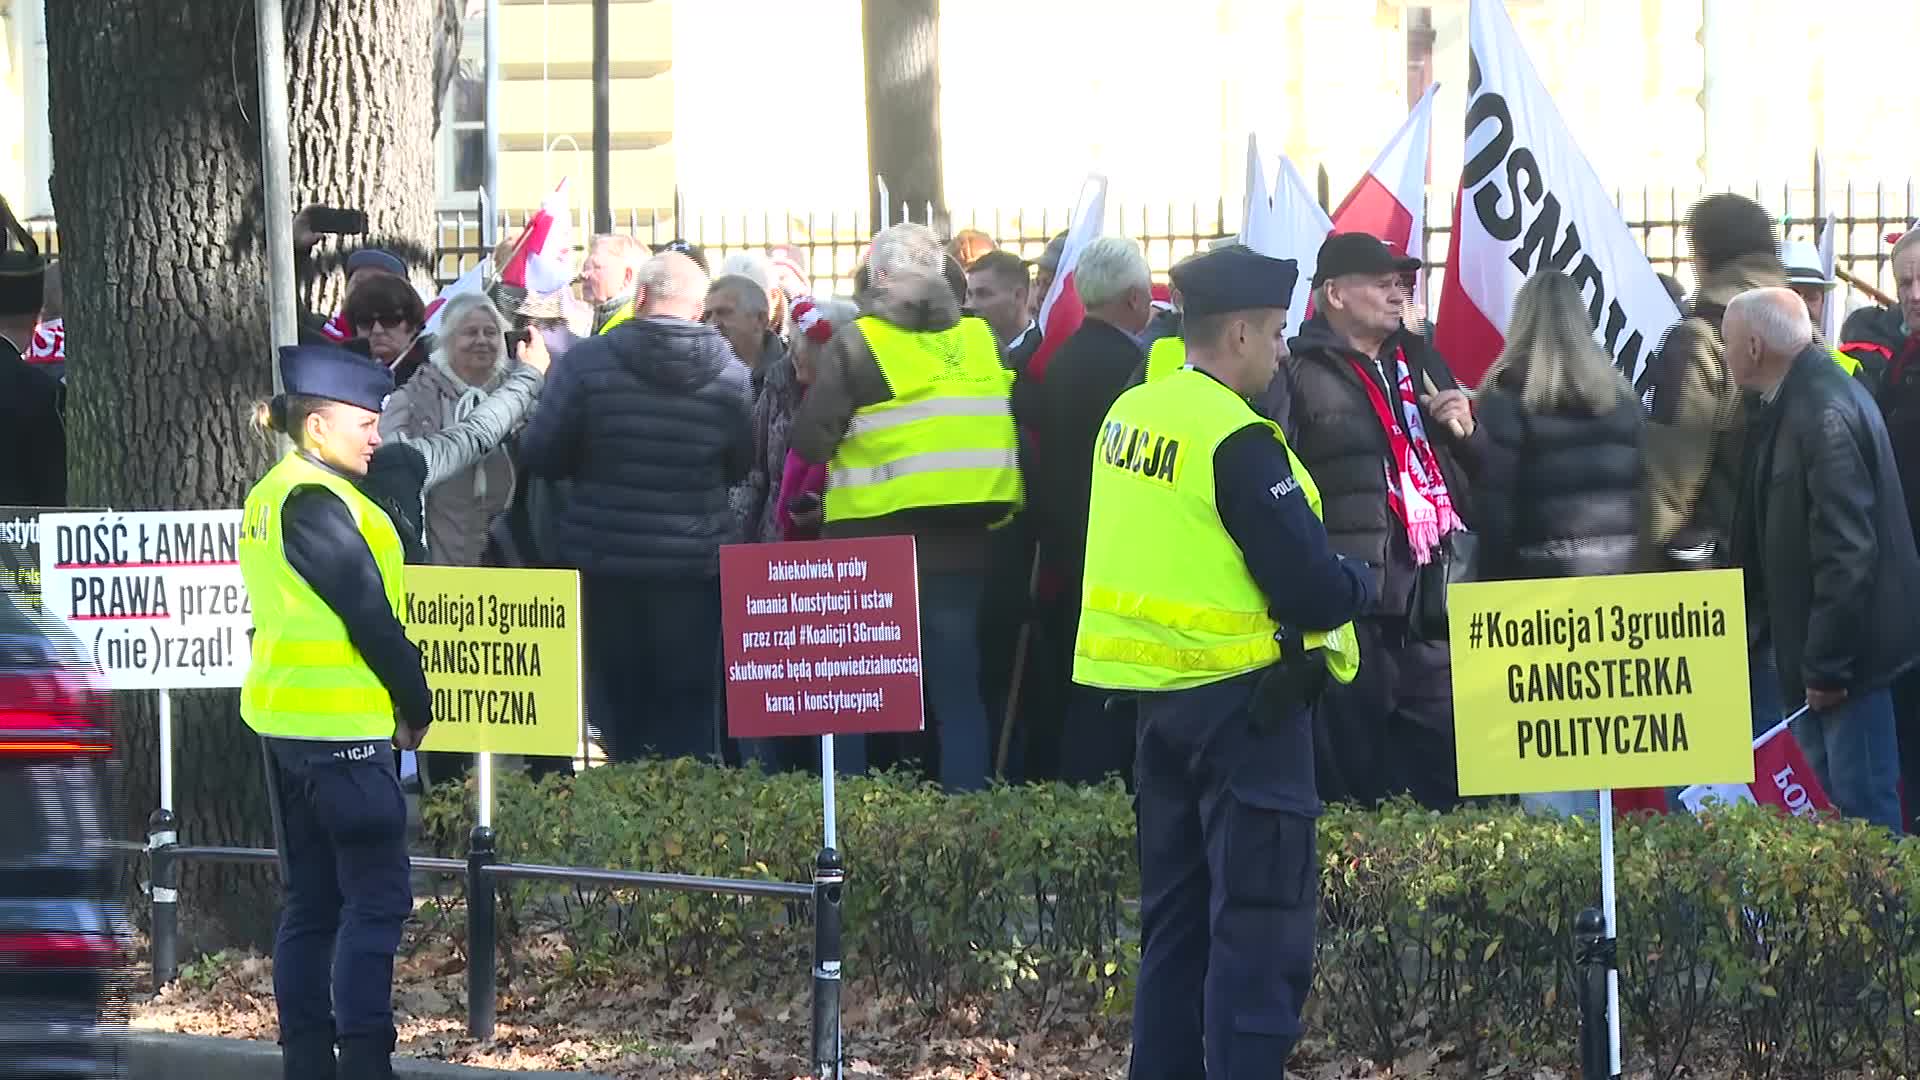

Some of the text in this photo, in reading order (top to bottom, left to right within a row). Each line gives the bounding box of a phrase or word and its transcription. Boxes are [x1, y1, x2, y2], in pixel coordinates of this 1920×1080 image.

[1098, 420, 1179, 483] POLICJA
[56, 516, 129, 566] DOŚĆ
[138, 522, 242, 566] ŁAMAN
[767, 556, 868, 582] Jakiekolwiek próby
[71, 575, 169, 617] PRAWA
[746, 589, 893, 616] łamania Konstytucji i ustaw
[742, 621, 901, 653] przez rząd #Koalicji13Grudnia
[1469, 600, 1726, 653] #Koalicja13grudnia
[94, 627, 233, 676] (nie)rząd!
[418, 640, 542, 678] GANGSTERKA
[729, 653, 919, 683] skutkować będą odpowiedzialnością
[1507, 656, 1693, 704] GANGSTERKA
[430, 688, 538, 725] OLITYCZNA
[765, 688, 884, 715] karną i konstytucyjną!
[1517, 712, 1690, 759] POLITYCZNA
